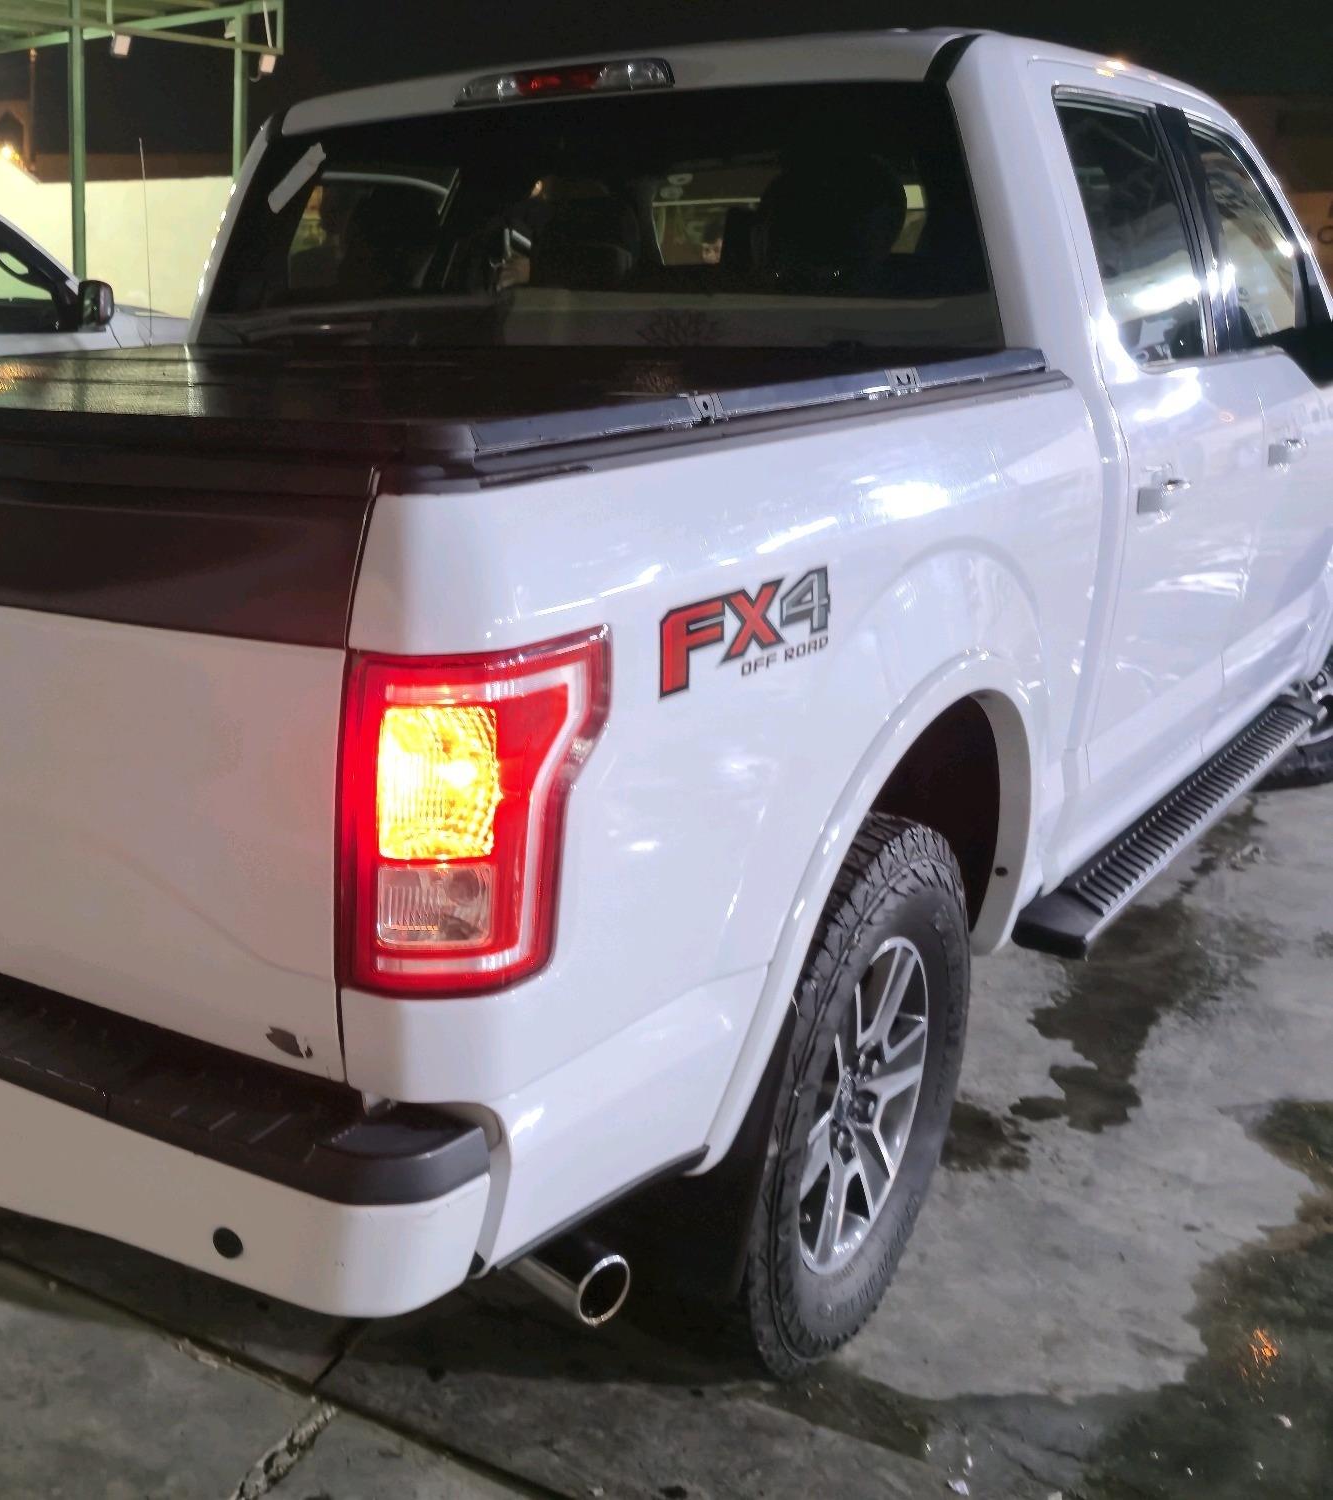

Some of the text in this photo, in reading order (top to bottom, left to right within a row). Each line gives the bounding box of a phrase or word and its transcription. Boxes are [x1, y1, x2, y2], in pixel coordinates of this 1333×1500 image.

[659, 566, 830, 699] FX4
[741, 636, 828, 676] OFF ROAD
